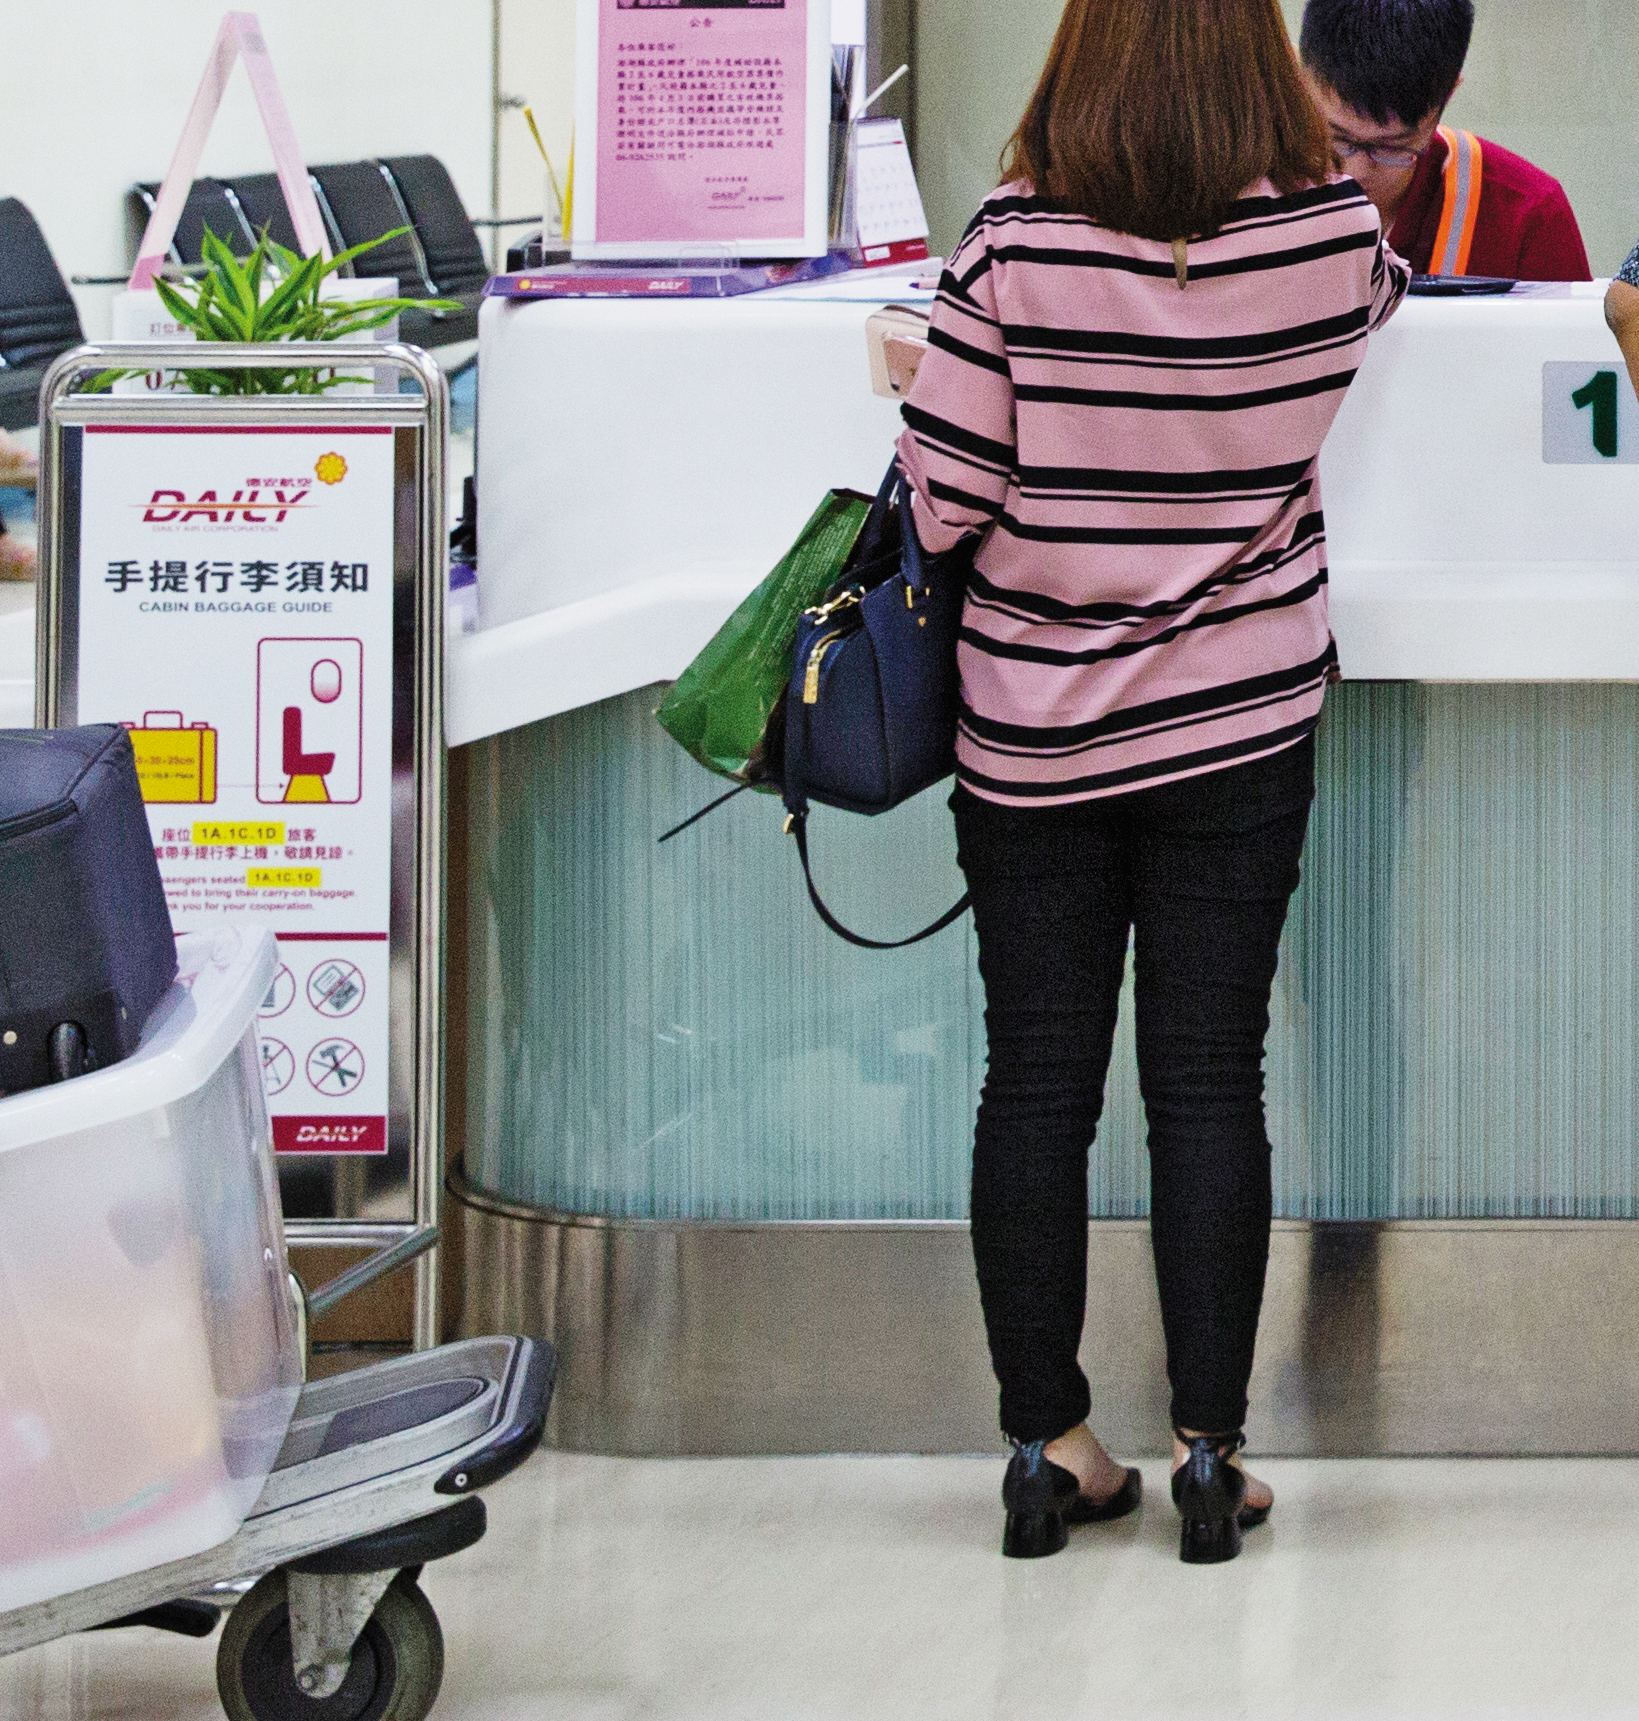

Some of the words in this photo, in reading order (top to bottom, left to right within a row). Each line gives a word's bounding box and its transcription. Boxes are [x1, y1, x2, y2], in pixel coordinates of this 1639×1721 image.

[1571, 370, 1618, 458] 1
[143, 490, 310, 523] DAILY
[105, 559, 369, 594] 手提行李須知
[139, 602, 189, 612] CABIN
[195, 601, 277, 612] BAGGAGE
[282, 602, 333, 612] GUIDE
[211, 875, 245, 884] seated
[191, 889, 202, 897] to
[204, 888, 232, 899] bring
[235, 888, 259, 897] their
[262, 889, 307, 899] carry-on
[182, 903, 203, 912] you
[205, 901, 219, 910] for
[222, 903, 247, 912] your
[296, 1126, 367, 1142] DAILY
